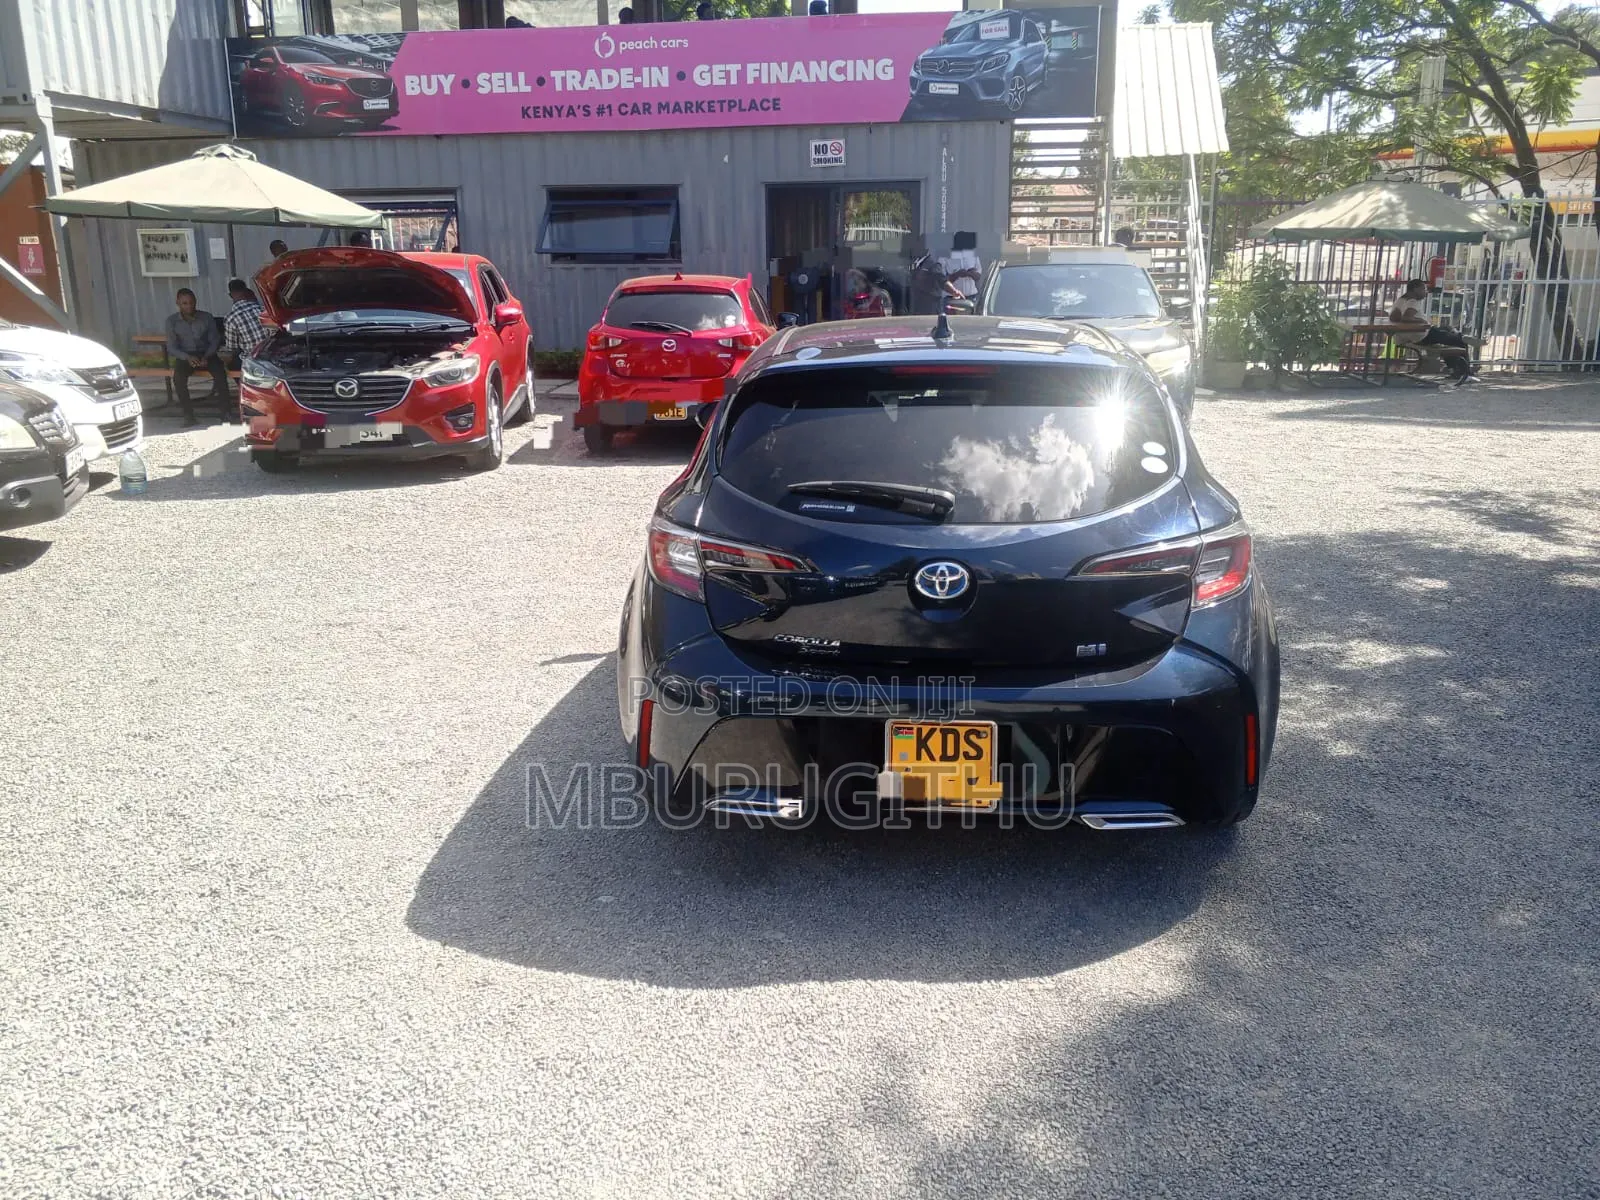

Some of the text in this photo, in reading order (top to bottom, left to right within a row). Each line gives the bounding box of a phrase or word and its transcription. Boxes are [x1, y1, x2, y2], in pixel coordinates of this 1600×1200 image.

[619, 36, 689, 54] peach cars
[404, 58, 895, 95] BUY SELL TRADE-IN GET FINANCING
[521, 97, 781, 119] KENYA'S #1 CAR MARKETPLACE
[814, 144, 828, 156] NO
[813, 156, 843, 165] SMOKING
[1568, 200, 1593, 211] SELEC
[774, 634, 841, 648] COROLLA
[915, 727, 984, 763] KDS
